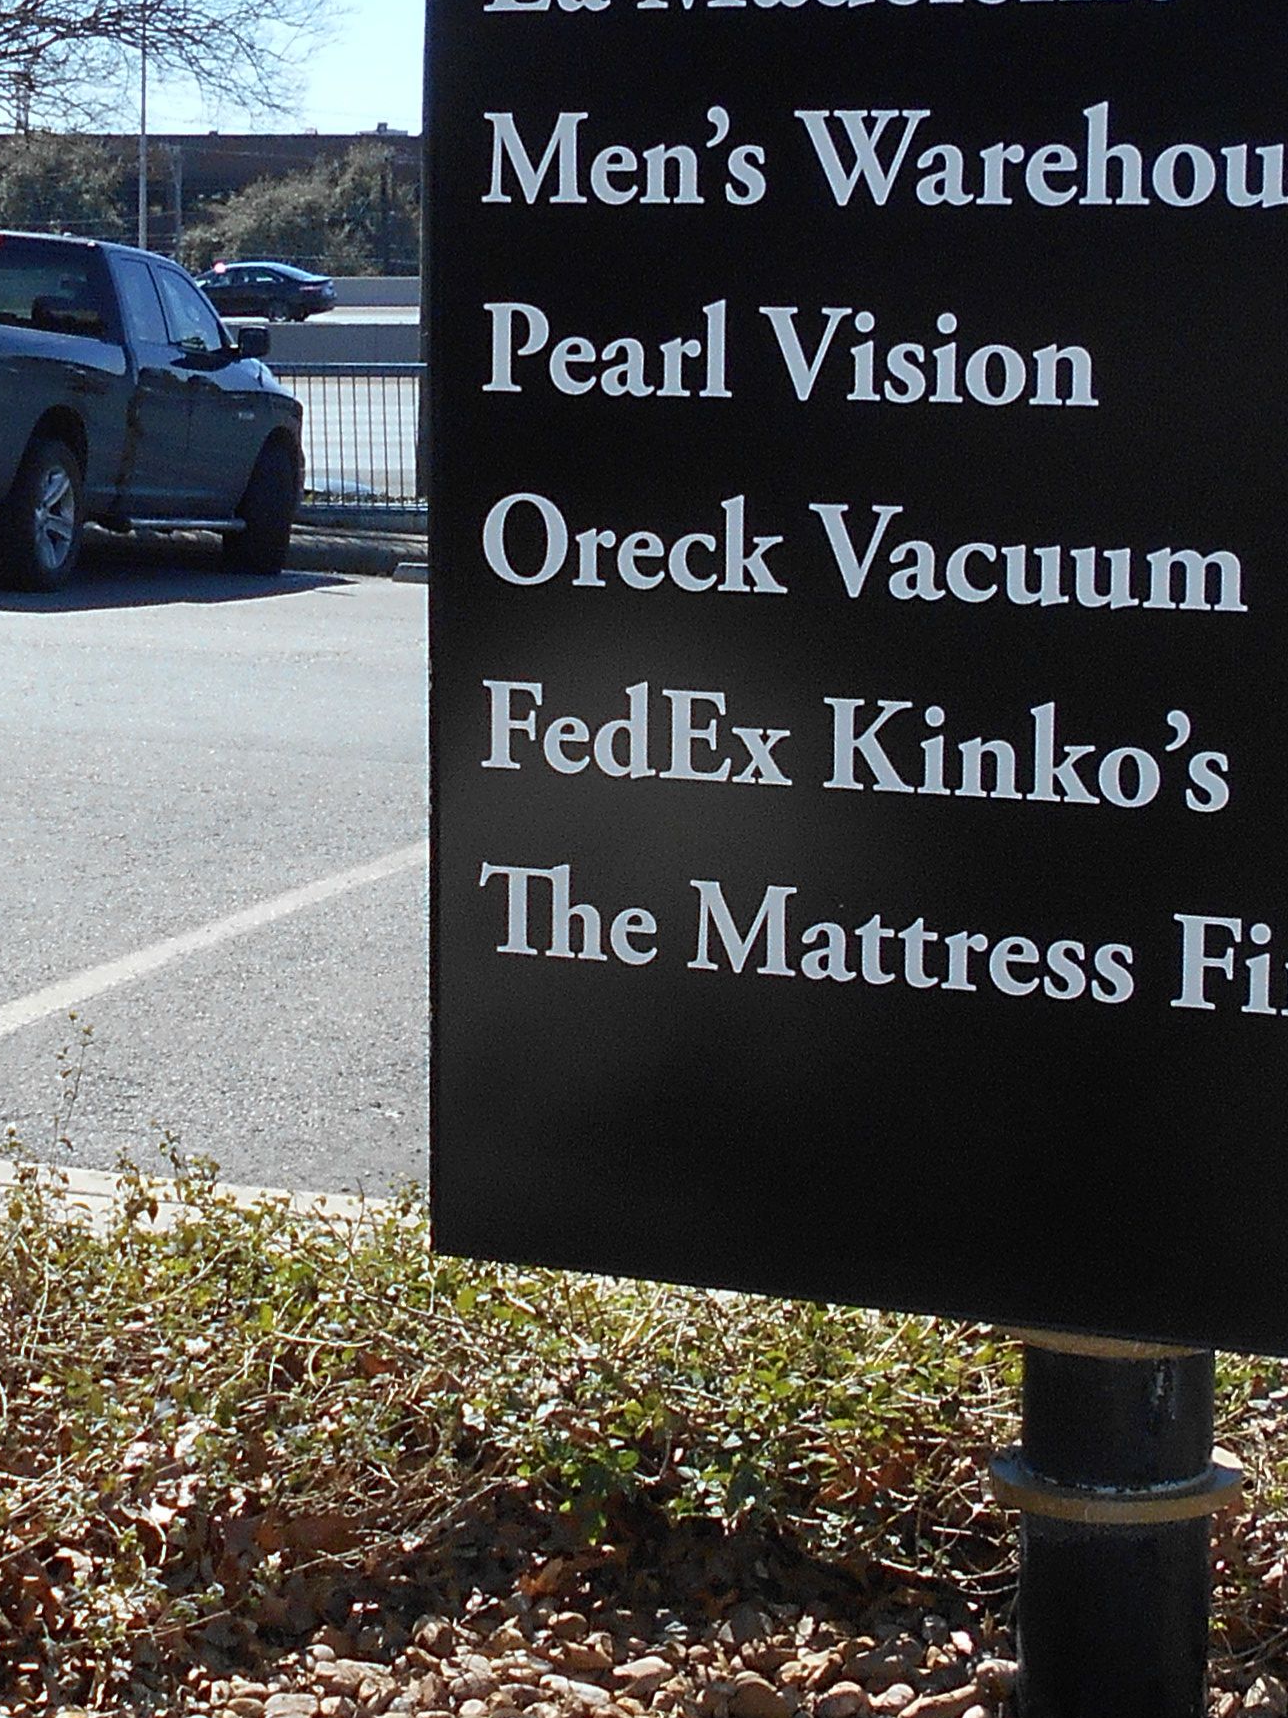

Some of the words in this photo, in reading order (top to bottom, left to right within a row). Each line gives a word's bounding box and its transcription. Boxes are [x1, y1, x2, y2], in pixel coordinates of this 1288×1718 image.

[481, 105, 767, 206] Men's
[481, 299, 733, 398] Pearl
[758, 306, 1100, 407] Vision
[482, 492, 788, 595] Oreck
[808, 503, 1249, 613] Vacuum
[480, 679, 793, 787] FedEx
[822, 696, 1230, 813] Kinko's
[478, 861, 658, 967] The
[686, 879, 1135, 1004] Mattress
